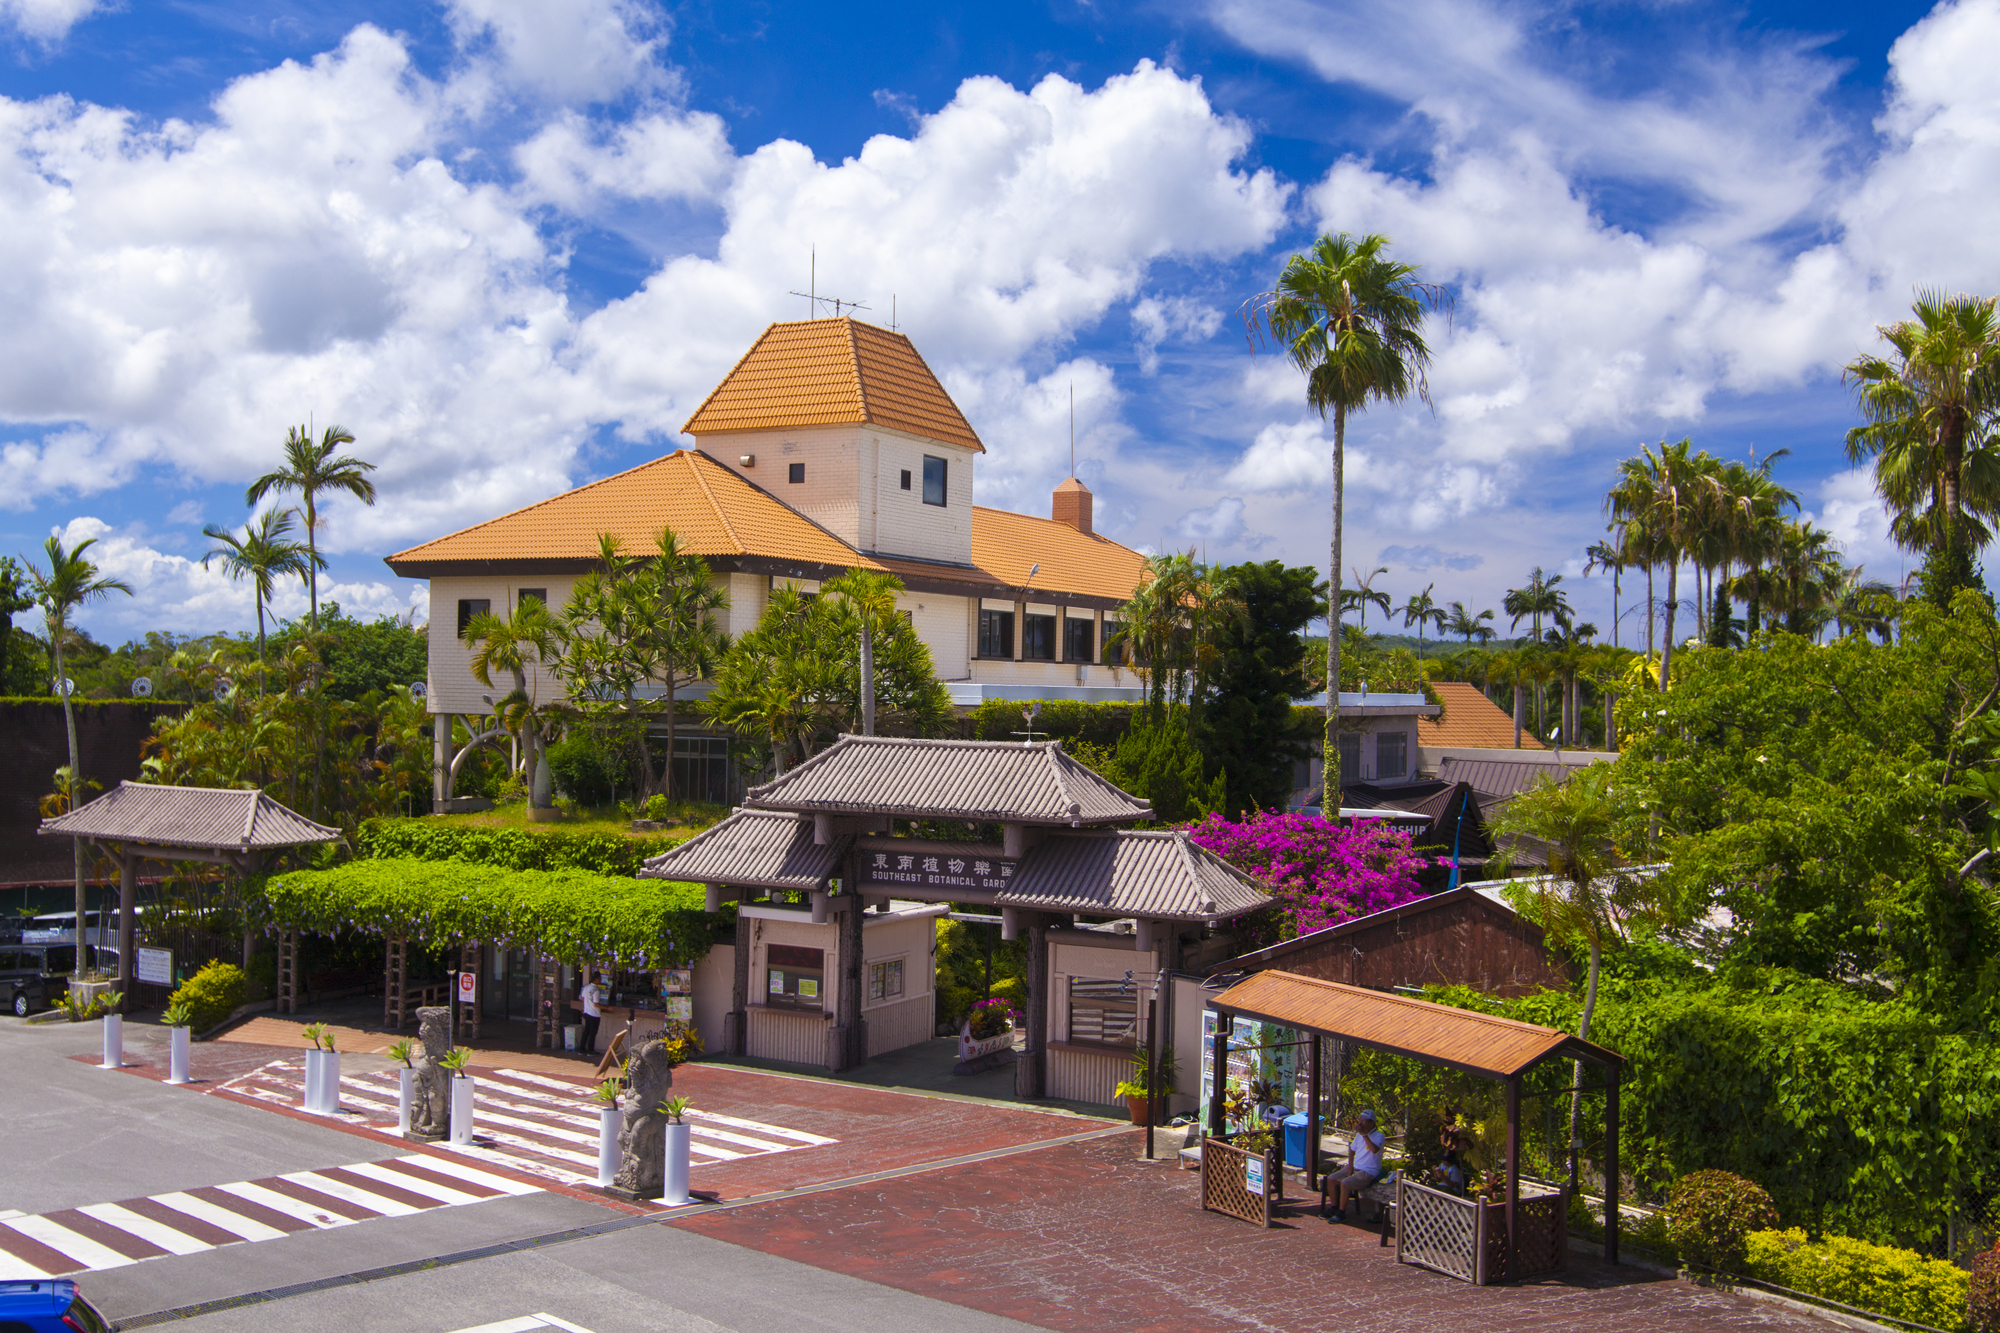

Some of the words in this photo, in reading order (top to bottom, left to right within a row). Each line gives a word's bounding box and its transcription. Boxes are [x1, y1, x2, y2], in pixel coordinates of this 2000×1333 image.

[872, 871, 922, 882] SOUTHEAST
[928, 875, 976, 887] BOTANICAL
[983, 878, 1008, 889] GARD
